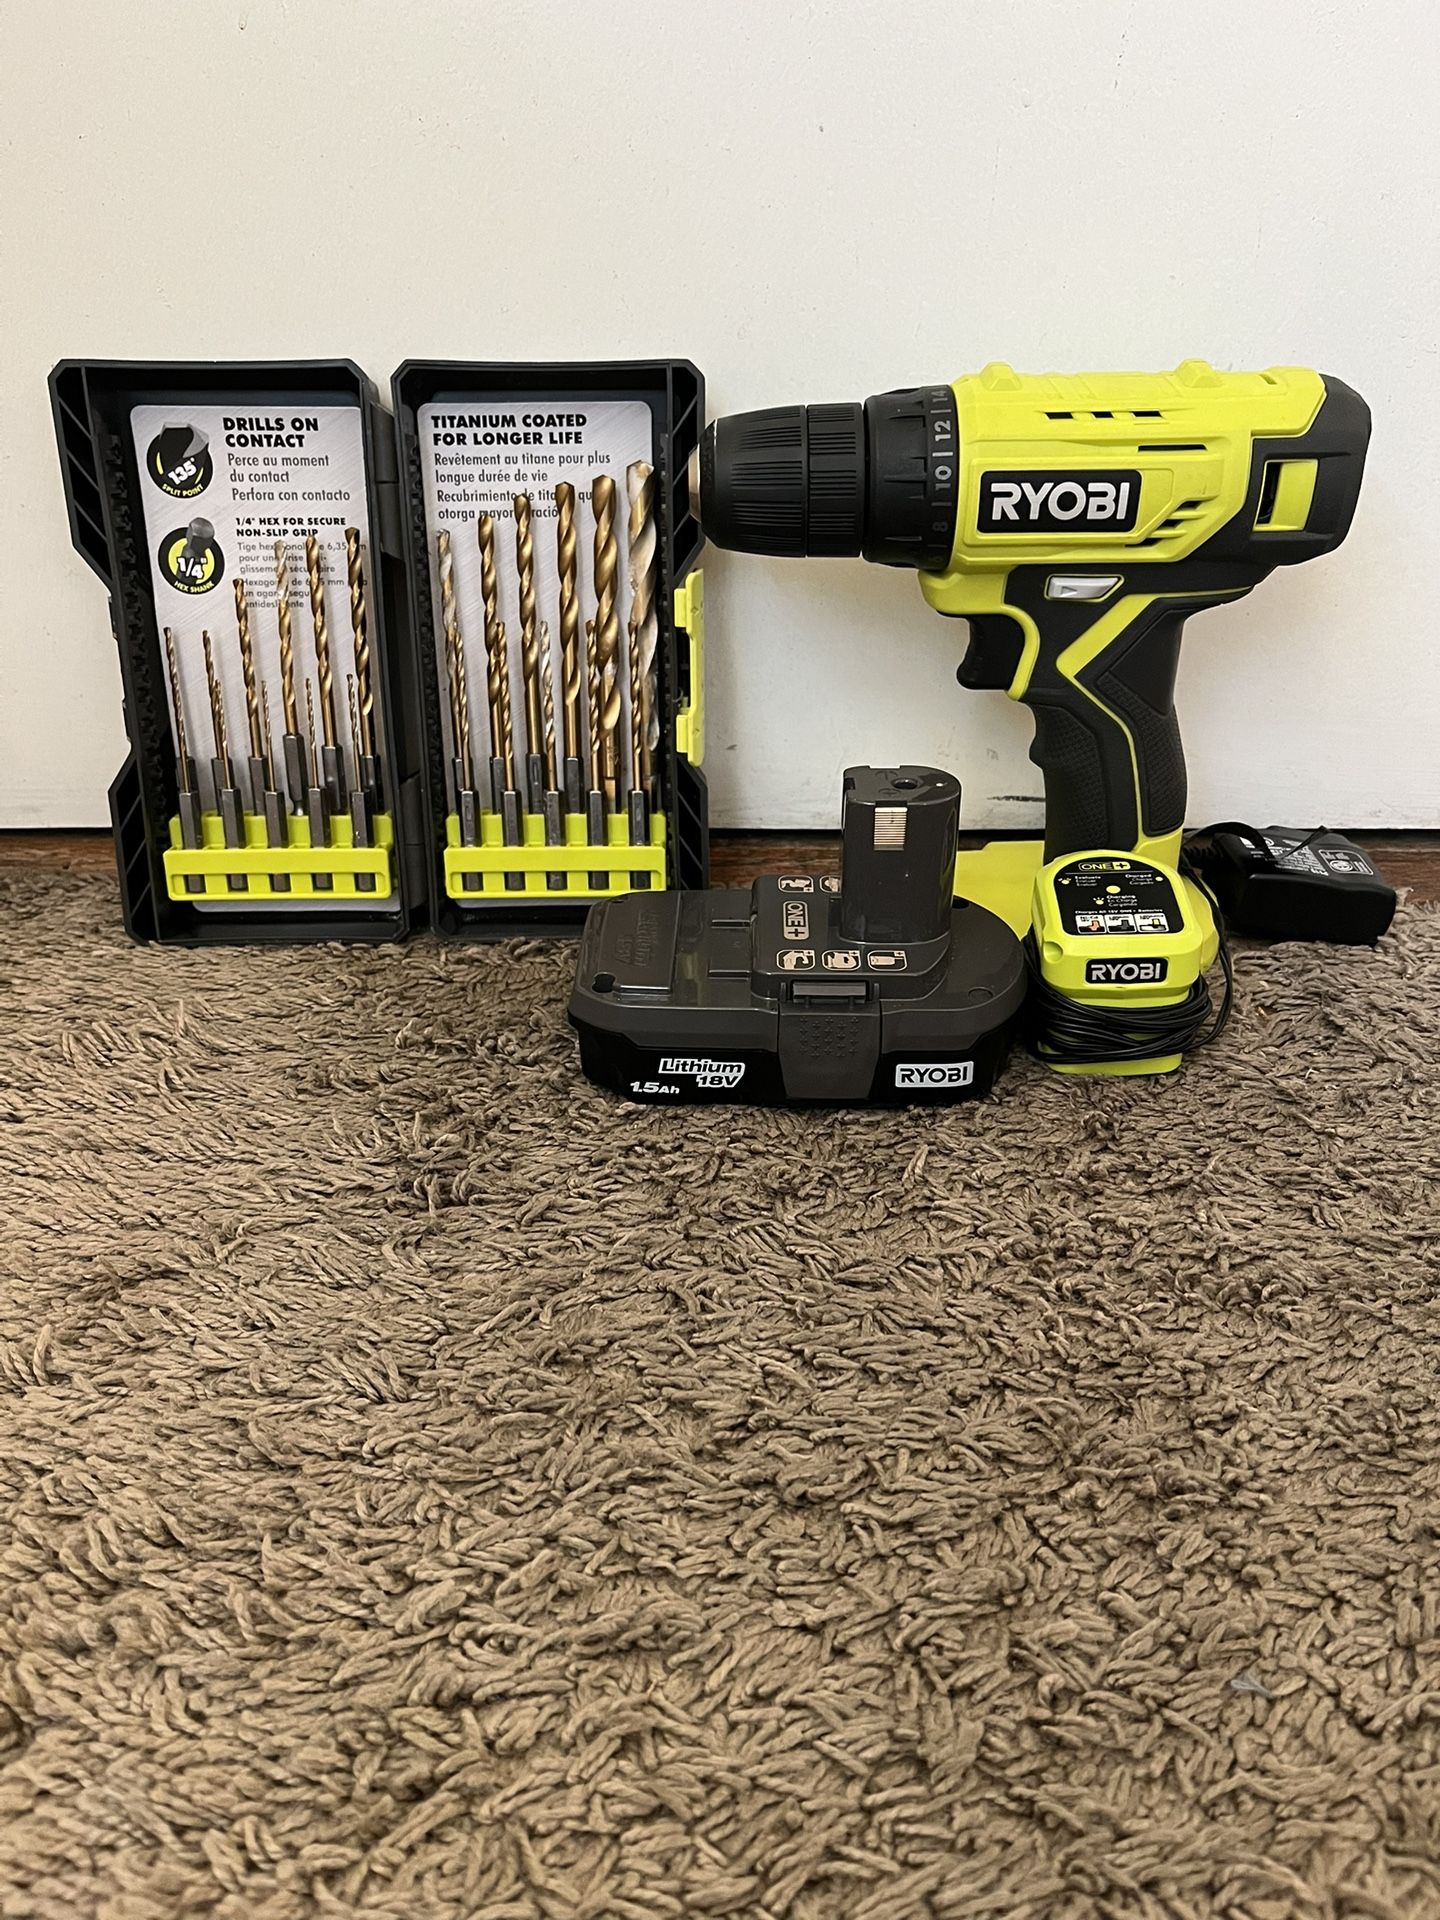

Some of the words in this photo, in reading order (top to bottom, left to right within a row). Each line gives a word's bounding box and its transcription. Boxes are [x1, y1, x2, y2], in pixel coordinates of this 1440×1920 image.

[223, 417, 285, 431] DRILLS
[291, 417, 319, 431] ON
[431, 414, 516, 428] TITANIUM
[522, 414, 587, 428] COATED
[934, 419, 952, 442] 12
[225, 434, 305, 448] CONTACT
[433, 432, 467, 446] FOR
[473, 432, 544, 445] LONGER
[549, 431, 583, 445] LIFE
[228, 453, 259, 466] Perce
[263, 457, 277, 466] au
[282, 455, 329, 467] moment
[434, 452, 500, 466] Revêtement
[504, 456, 519, 465] au
[522, 453, 555, 465] titane
[558, 455, 584, 467] pour
[587, 450, 611, 467] plus
[230, 470, 244, 482] du
[249, 471, 290, 482] contact
[435, 470, 475, 486] longue
[478, 468, 511, 483] durée
[514, 468, 528, 482] de
[531, 469, 548, 482] vie
[934, 465, 952, 491] 10
[162, 483, 181, 497] SPLIT
[183, 485, 204, 497] POINT
[232, 488, 275, 501] Perfora
[278, 491, 298, 501] con
[301, 489, 350, 501] contacto
[437, 489, 517, 502] Recubrimiento
[578, 491, 593, 503] qu
[990, 481, 1130, 520] RYOBI
[259, 517, 279, 525] HEX
[284, 517, 304, 525] FOR
[308, 517, 346, 525] SECURE
[438, 508, 476, 521] otorga
[236, 529, 289, 537] NON-SLIP
[293, 529, 318, 537] GRIP
[237, 542, 256, 552] Tige
[239, 555, 259, 563] pour
[174, 580, 189, 592] HEX
[190, 581, 214, 593] SHANK
[291, 578, 303, 586] de
[1090, 963, 1161, 981] RYOBI
[661, 1059, 742, 1073] Lithium
[698, 1075, 739, 1087] 18V
[900, 1065, 968, 1084] RYOBI
[630, 1081, 680, 1094] 1.5Ah
